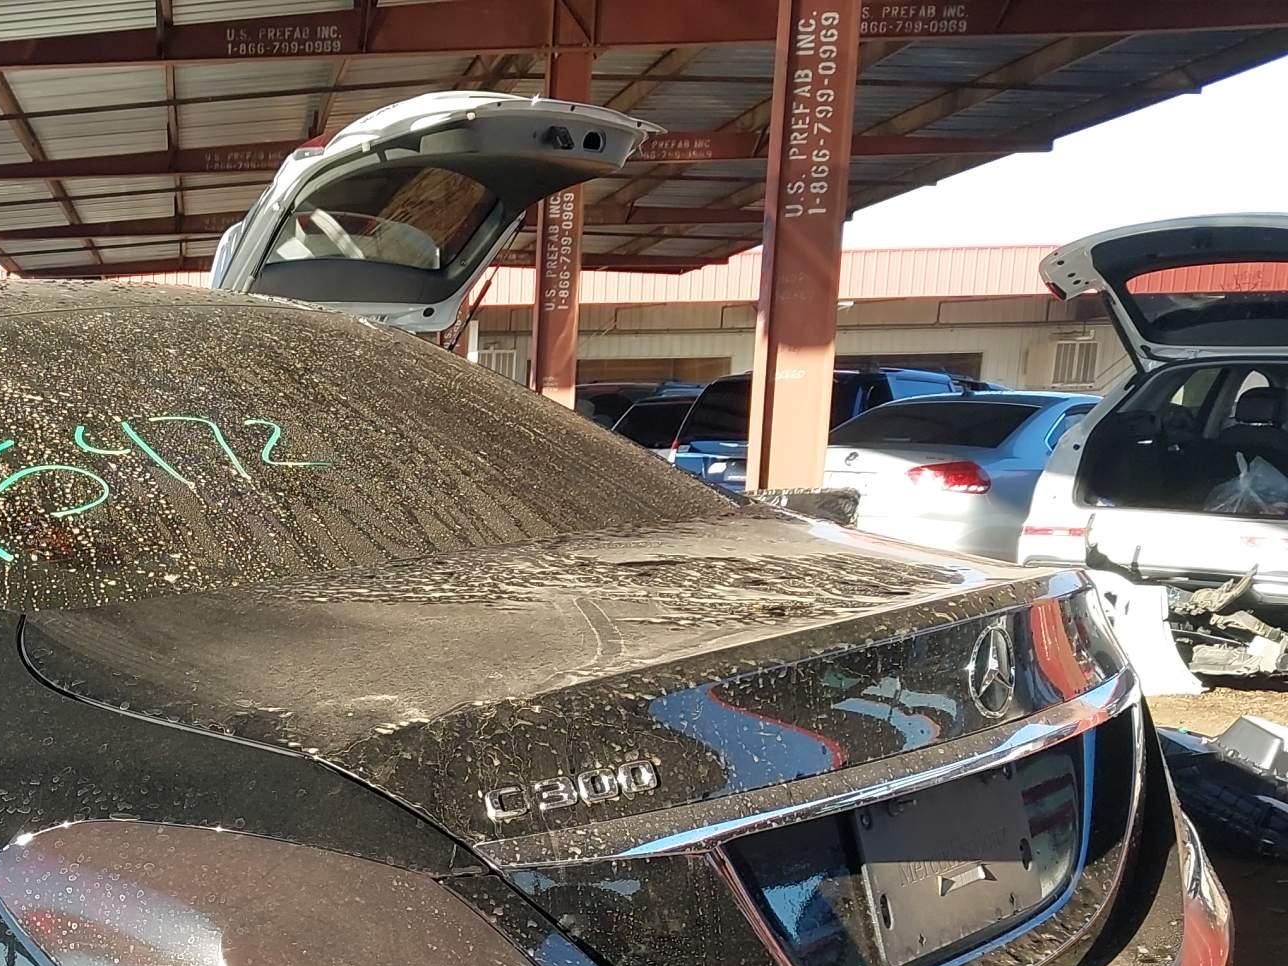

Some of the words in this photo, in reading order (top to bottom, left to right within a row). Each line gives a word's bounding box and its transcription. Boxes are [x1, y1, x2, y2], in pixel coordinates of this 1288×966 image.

[227, 28, 251, 41] U.S.
[258, 26, 310, 40] PREFAB
[317, 25, 343, 39] INC.
[796, 11, 817, 55] INC.
[882, 5, 936, 18] PREFAB
[943, 4, 969, 17] INC.
[227, 40, 342, 55] 1-866-799-0969
[789, 68, 812, 160] PREFAB
[808, 11, 840, 215] 1-866-799-0969
[784, 173, 806, 218] U.S.
[546, 225, 560, 278] PREFAB
[557, 192, 575, 310] 1-866-799-0969
[544, 285, 557, 311] U.S.
